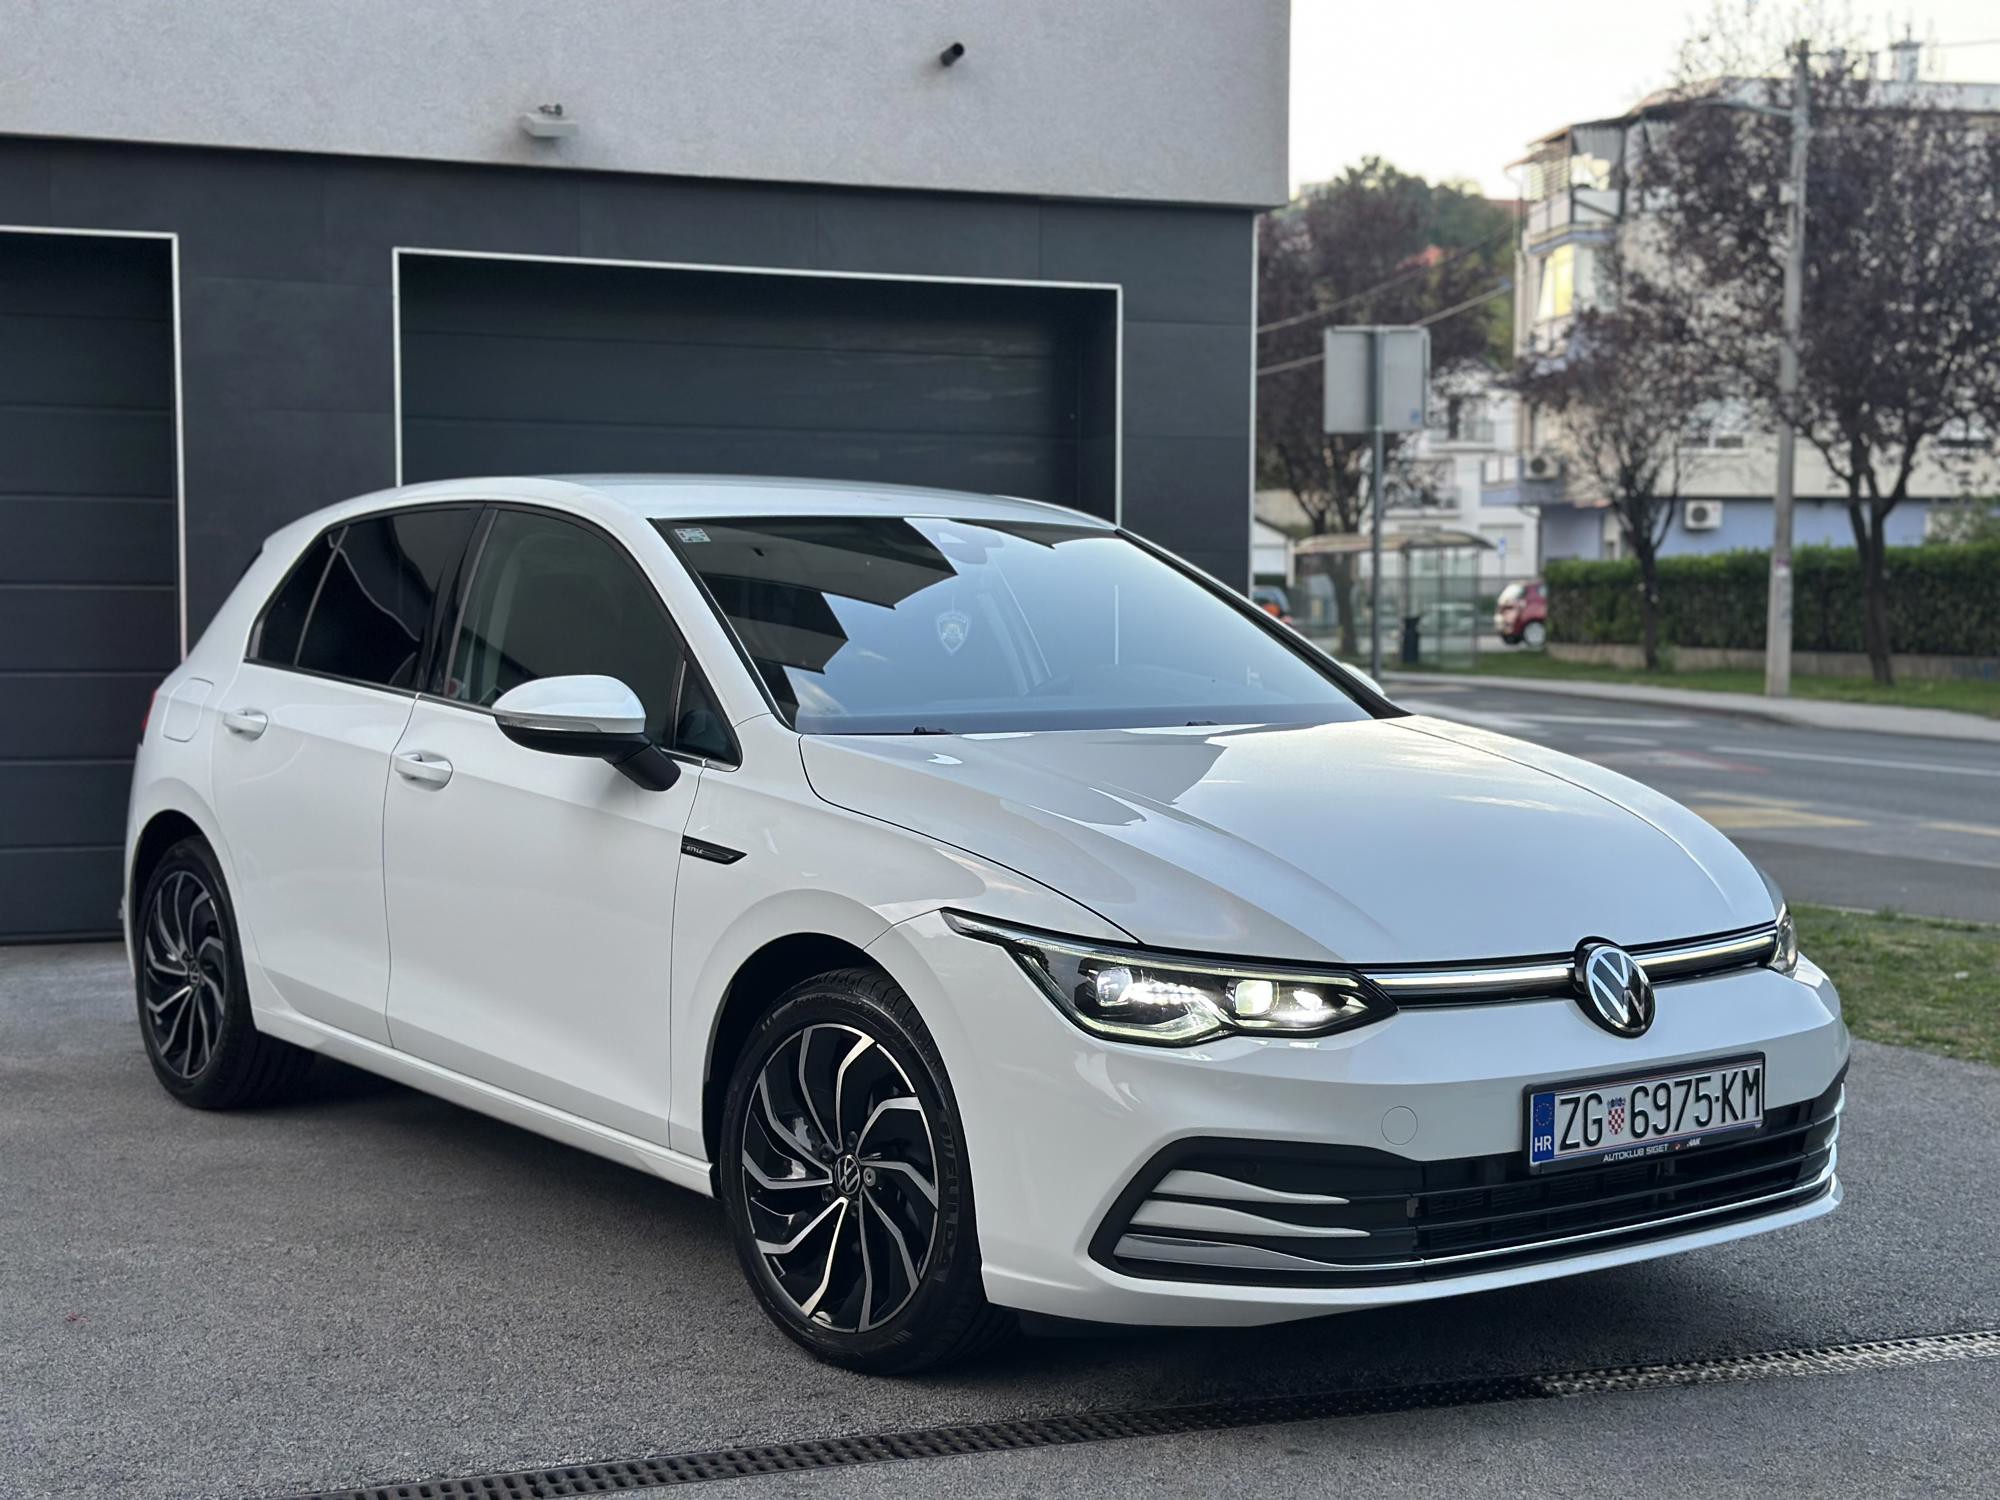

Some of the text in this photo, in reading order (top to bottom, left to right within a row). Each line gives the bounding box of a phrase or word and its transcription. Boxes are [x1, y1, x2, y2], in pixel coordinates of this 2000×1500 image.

[1560, 1092, 1603, 1150] ZG
[1534, 1135, 1552, 1152] HR
[1603, 1143, 1669, 1162] AUTOKLUB SIGET
